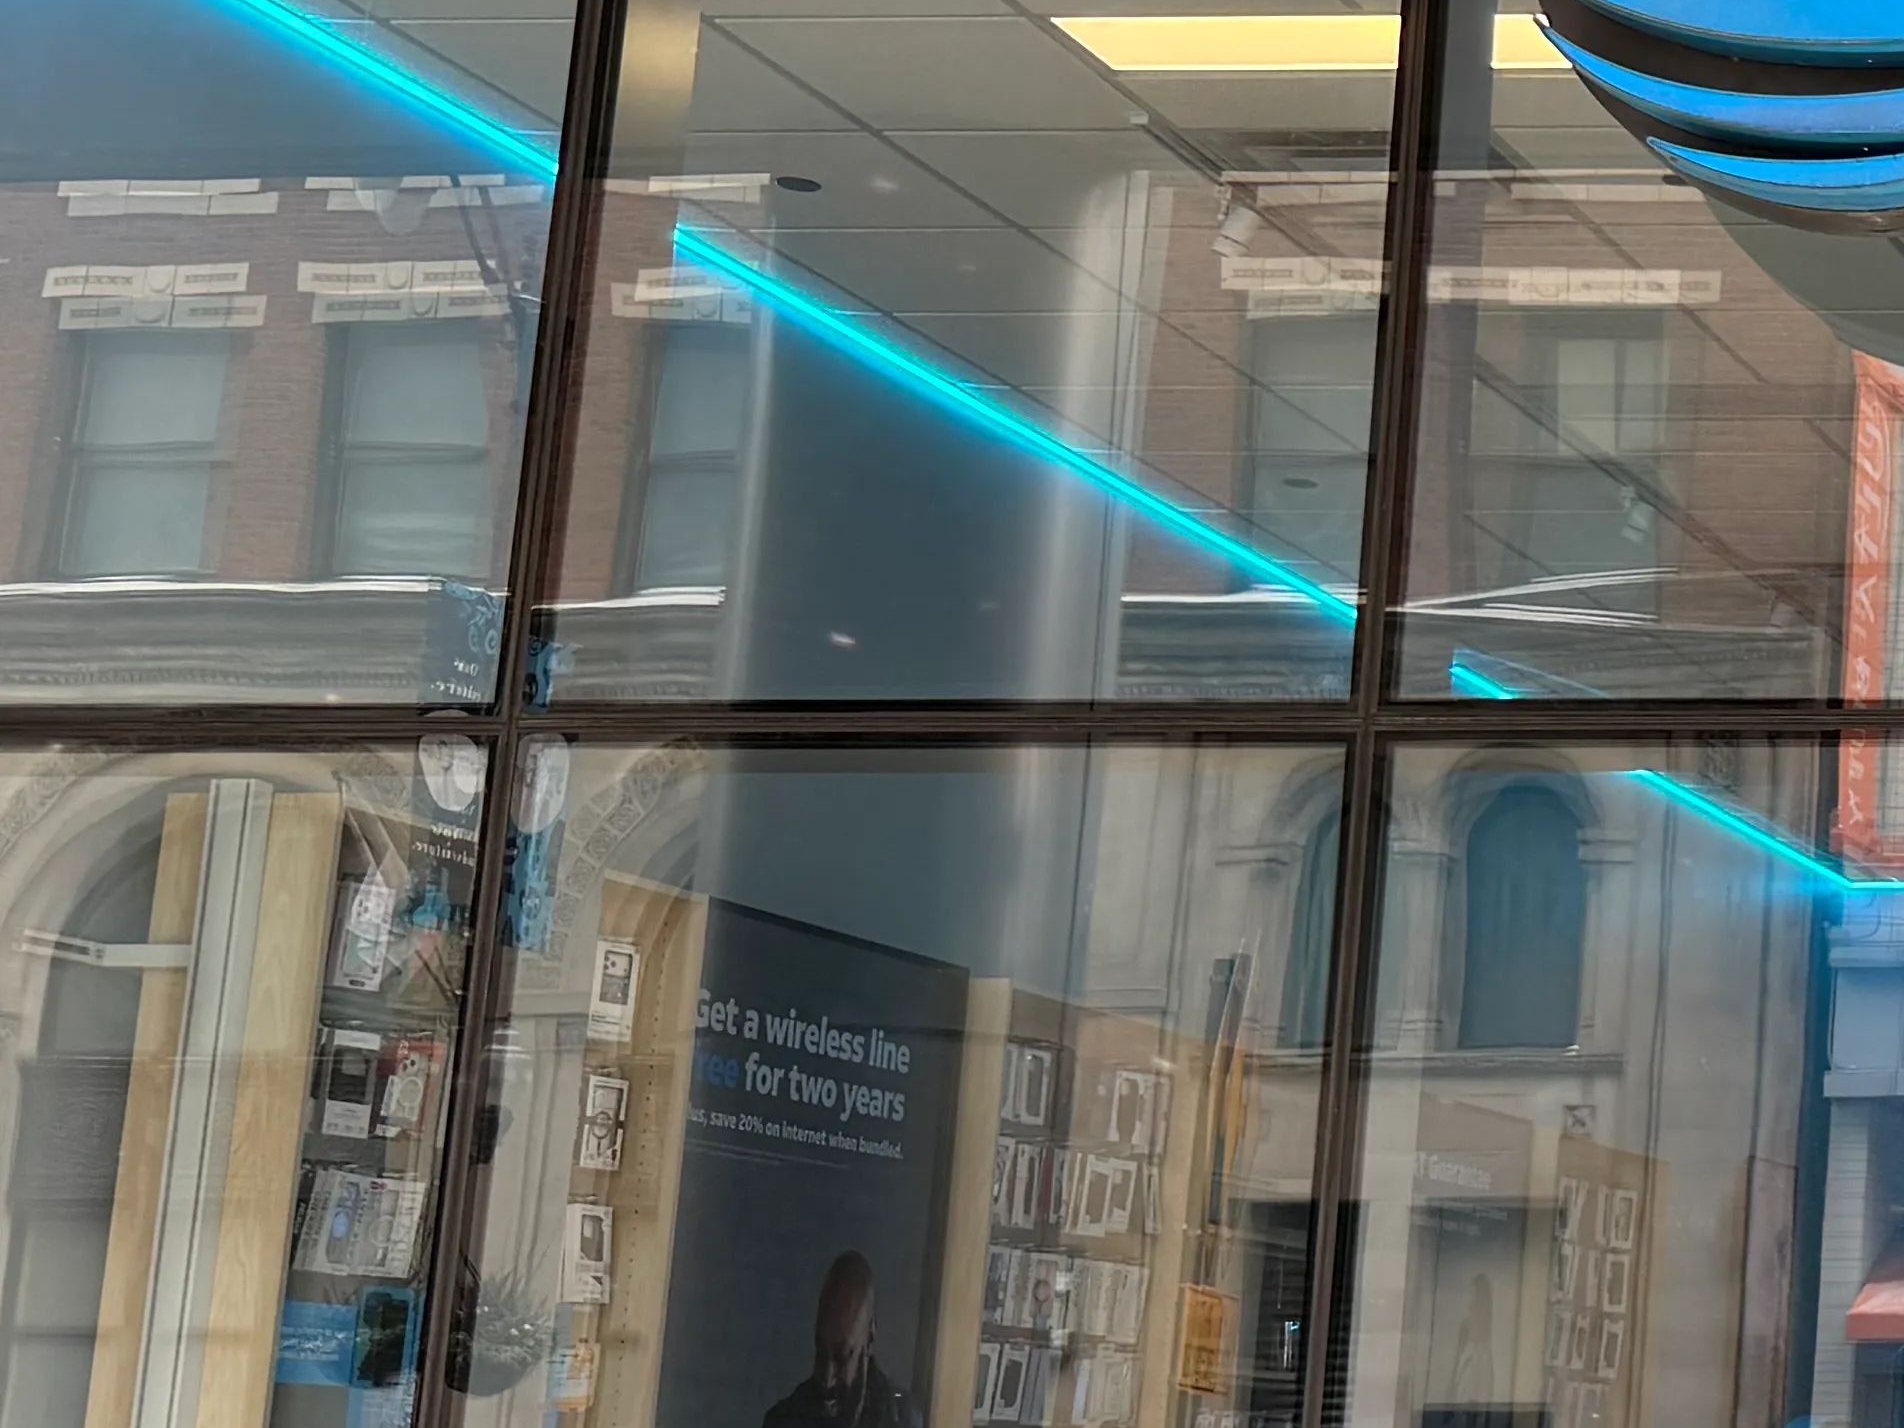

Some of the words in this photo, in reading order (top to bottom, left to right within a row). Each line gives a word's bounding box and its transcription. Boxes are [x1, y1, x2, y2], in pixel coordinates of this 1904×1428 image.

[696, 988, 739, 1035] Get
[743, 1008, 760, 1040] a
[765, 1008, 866, 1063] wireless
[868, 1028, 911, 1073] line
[693, 1046, 740, 1089] ree
[745, 1052, 785, 1097] for
[788, 1065, 837, 1108] two
[839, 1081, 906, 1122] years
[709, 1113, 737, 1131] save
[738, 1113, 764, 1135] 20%
[765, 1122, 780, 1138] on
[782, 1121, 827, 1146] internet
[828, 1131, 857, 1152] when
